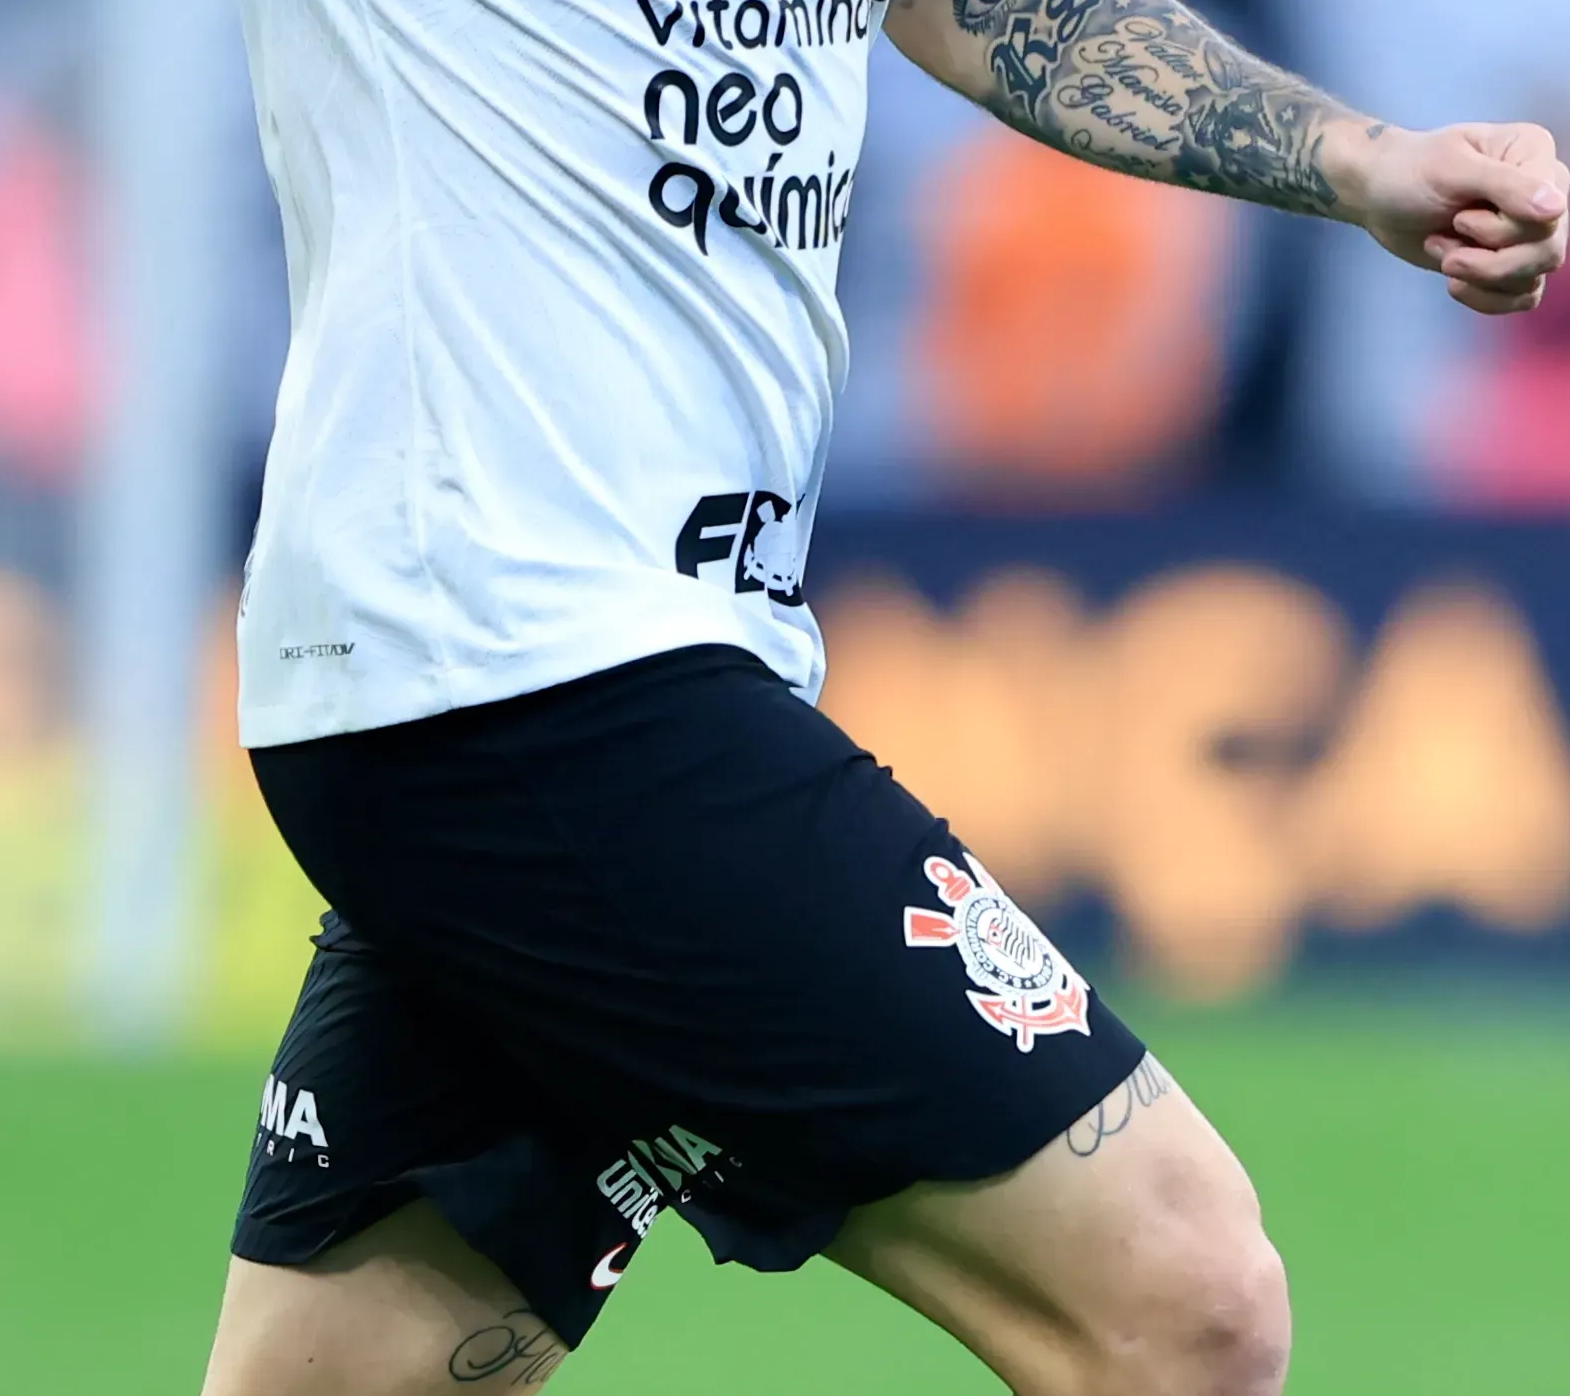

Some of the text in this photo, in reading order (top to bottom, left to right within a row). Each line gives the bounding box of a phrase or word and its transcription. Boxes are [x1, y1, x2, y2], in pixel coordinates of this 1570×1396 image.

[644, 69, 803, 147] neo
[648, 150, 855, 256] químic
[260, 1073, 329, 1148] MA
